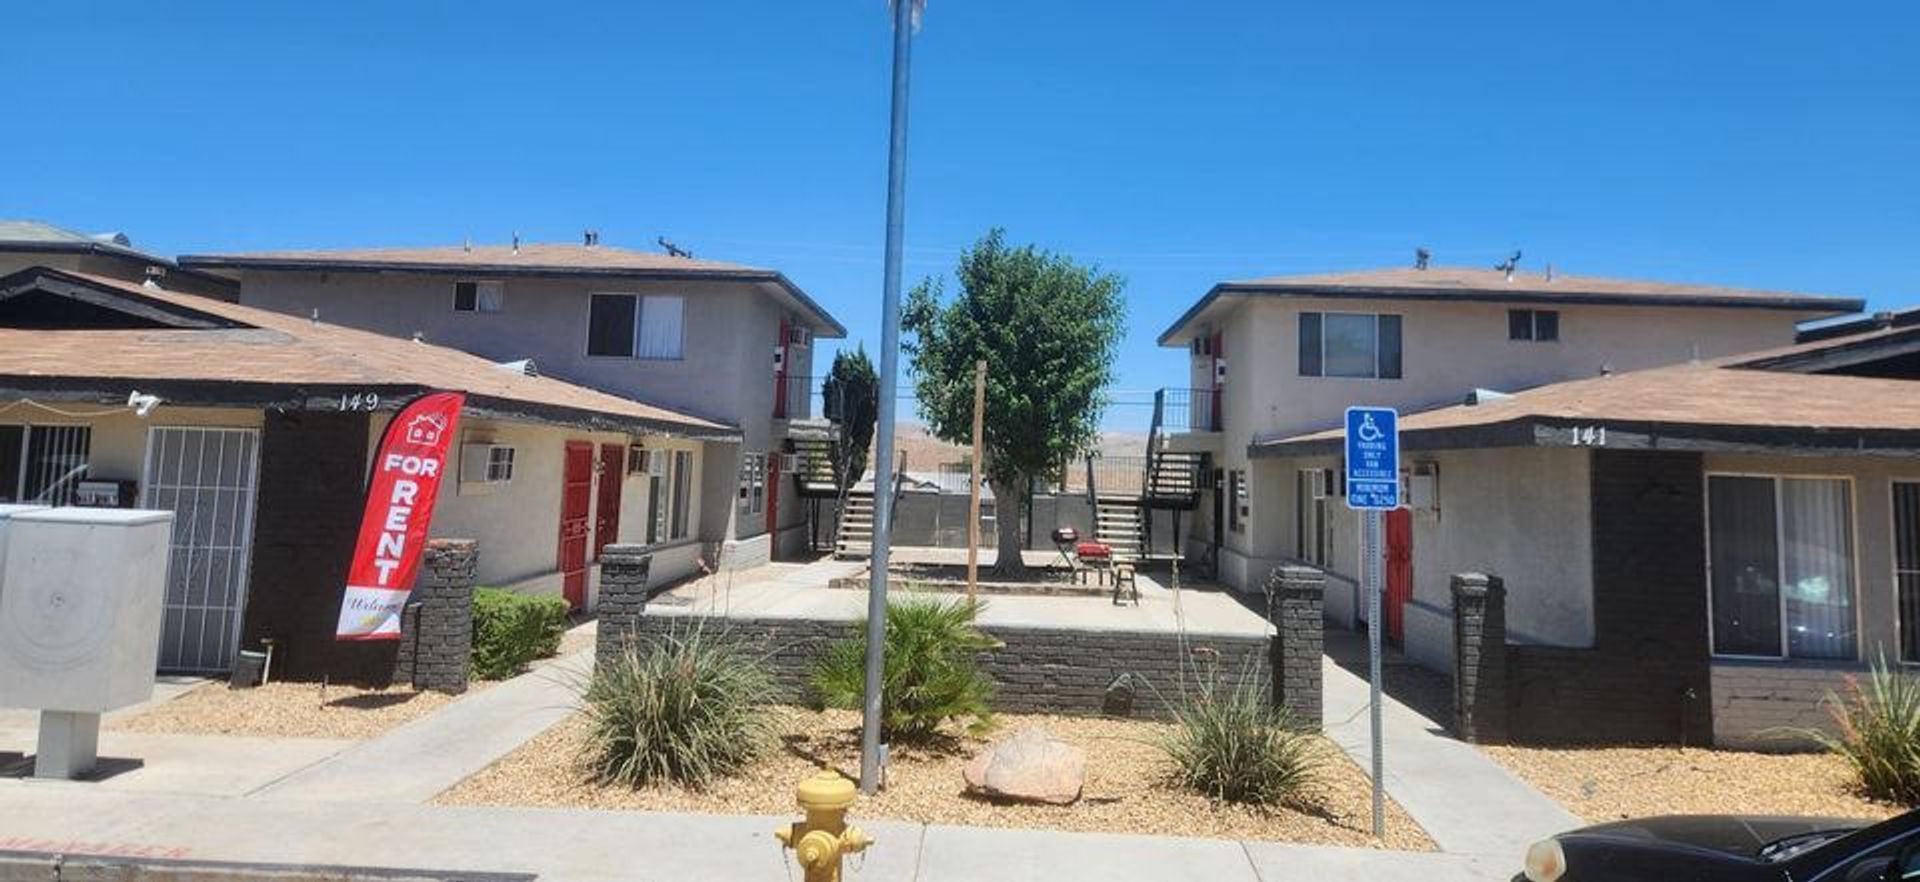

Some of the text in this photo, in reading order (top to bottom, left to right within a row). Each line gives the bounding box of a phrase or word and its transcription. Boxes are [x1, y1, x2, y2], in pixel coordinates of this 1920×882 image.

[340, 392, 378, 411] 149
[1572, 426, 1605, 445] 141
[385, 454, 439, 477] FOR
[374, 479, 420, 585] RENT
